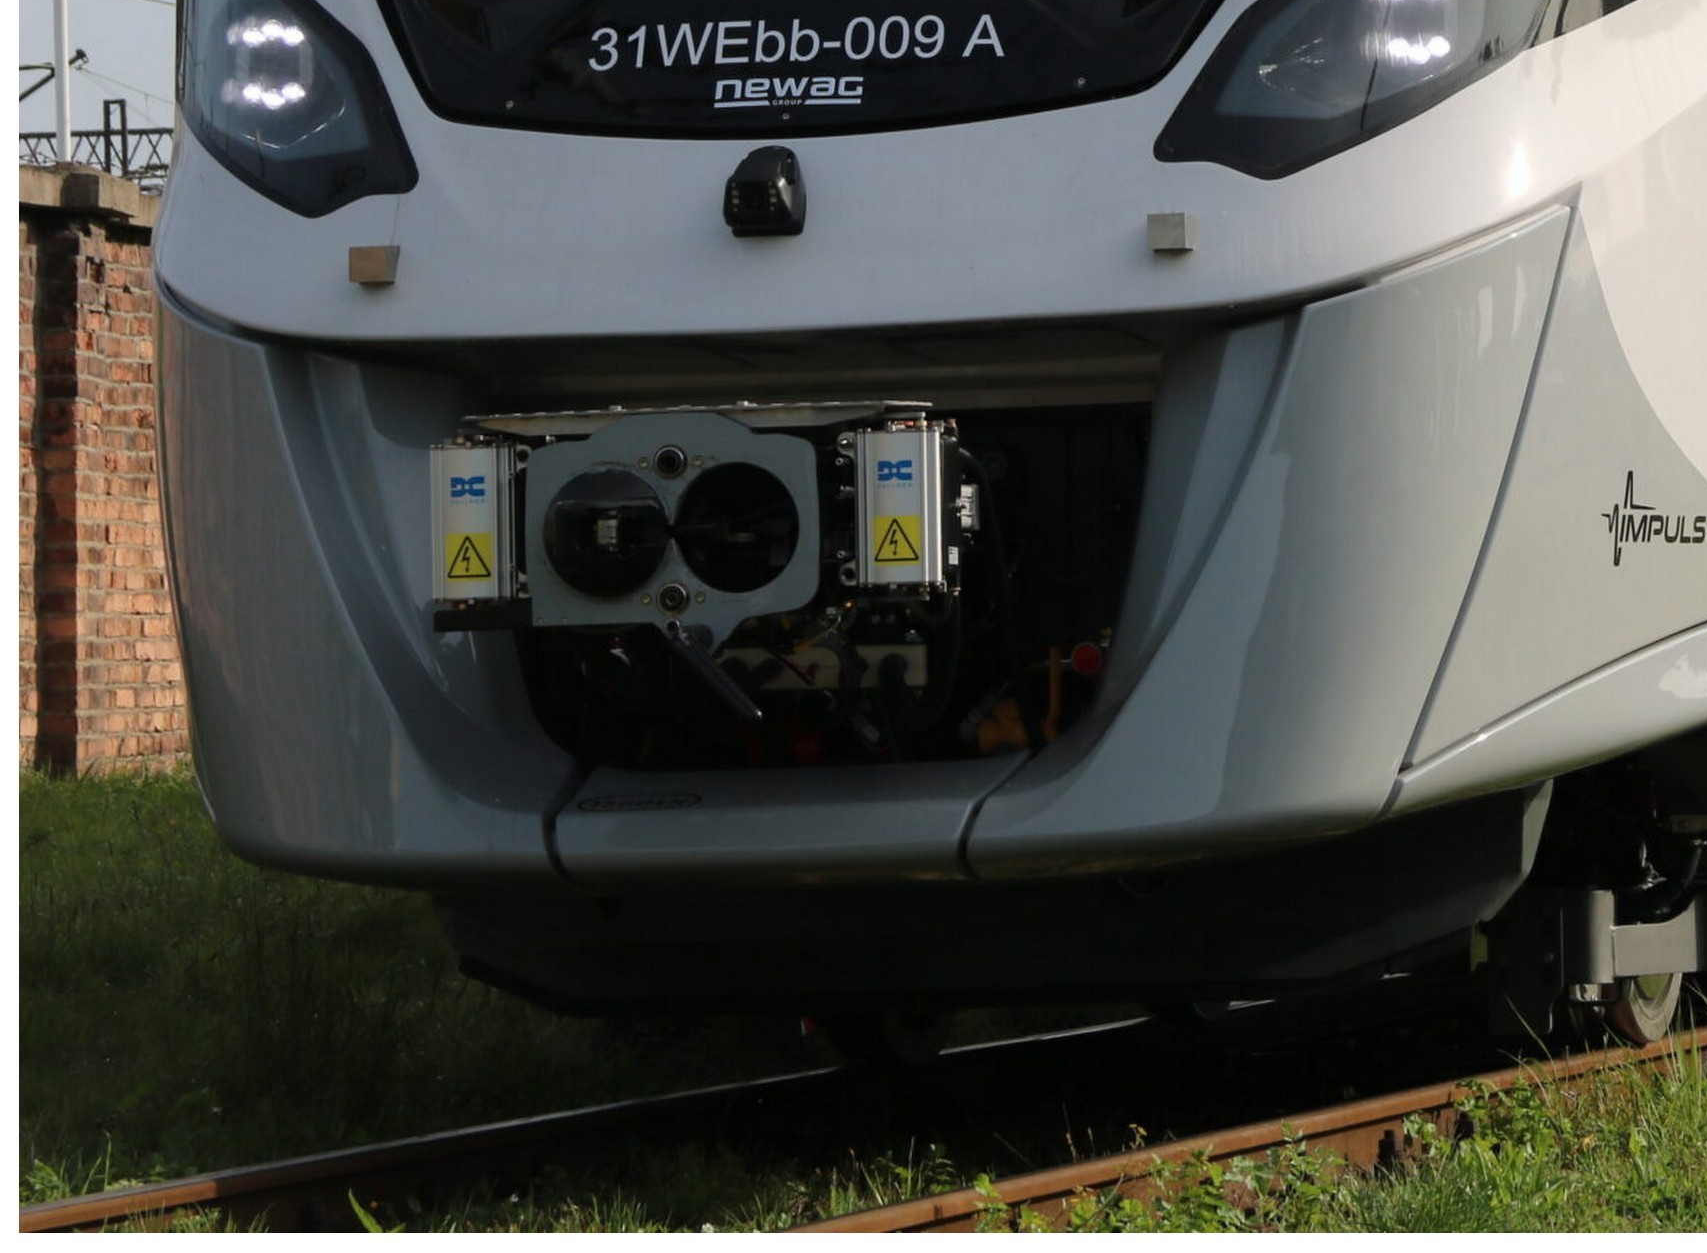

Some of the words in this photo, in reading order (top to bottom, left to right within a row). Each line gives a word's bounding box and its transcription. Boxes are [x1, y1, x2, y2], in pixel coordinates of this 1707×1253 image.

[588, 14, 947, 72] 31WEbb-009
[963, 13, 1005, 58] A
[714, 75, 864, 101] newag
[772, 98, 804, 107] GROUP
